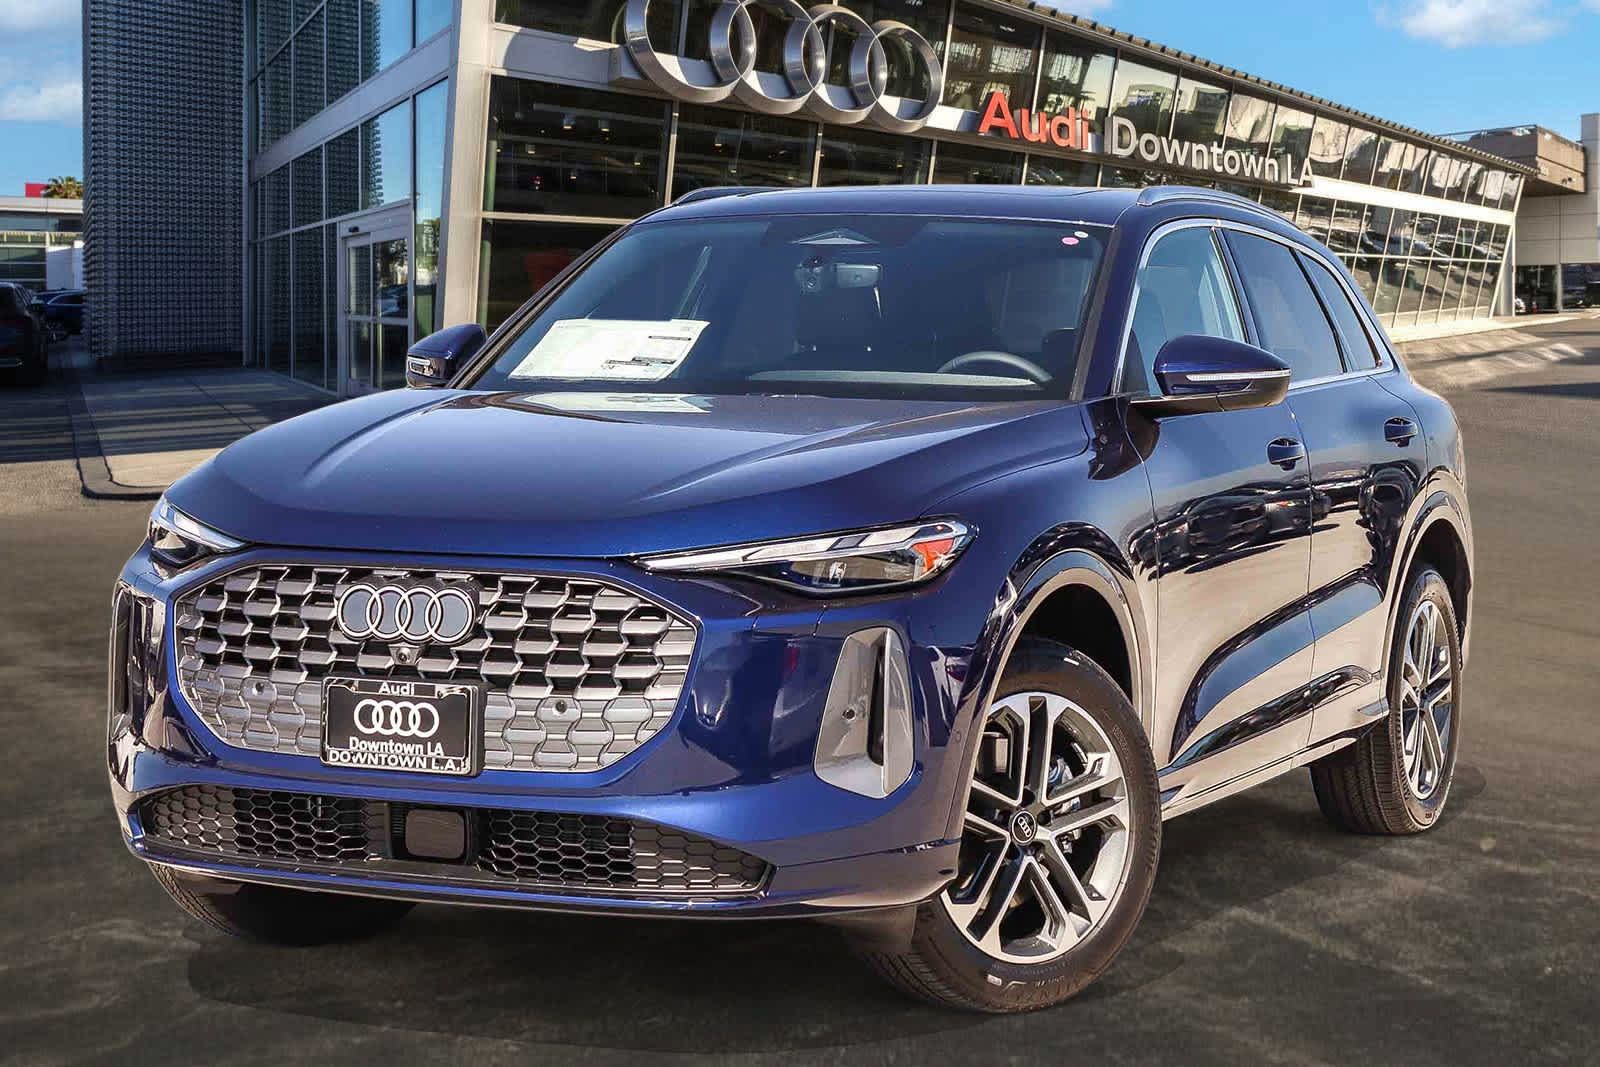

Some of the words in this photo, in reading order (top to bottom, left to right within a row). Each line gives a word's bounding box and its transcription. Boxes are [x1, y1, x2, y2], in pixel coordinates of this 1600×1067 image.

[977, 91, 1089, 151] Audi
[1107, 115, 1280, 184] Downtown
[1285, 154, 1315, 187] LA
[378, 682, 415, 697] Audi
[349, 736, 425, 755] Downtown
[428, 741, 445, 757] LA
[329, 751, 427, 769] DOWNTOWN
